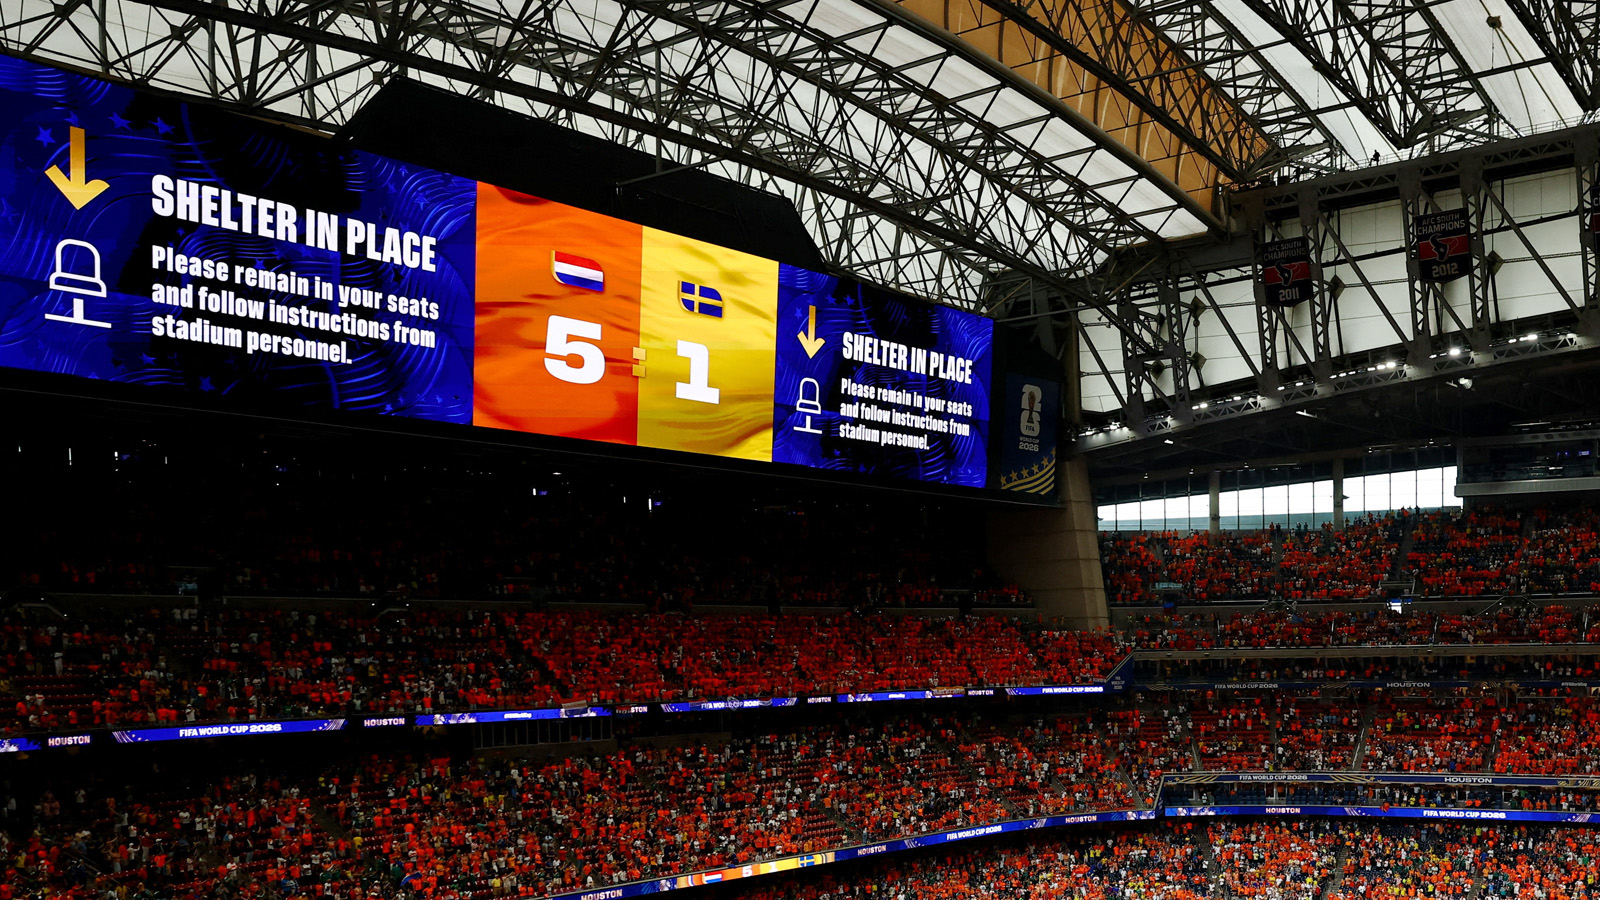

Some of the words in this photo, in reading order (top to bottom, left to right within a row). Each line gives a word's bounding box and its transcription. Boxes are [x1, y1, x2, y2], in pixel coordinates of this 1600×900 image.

[152, 174, 297, 243] SHELTER
[305, 208, 339, 252] IN
[346, 217, 437, 273] PLACE
[1422, 217, 1435, 226] AFC
[1436, 213, 1460, 223] SOUTH
[1417, 219, 1466, 236] CHAMPIONS
[1280, 240, 1302, 250] SOUTH
[1263, 247, 1306, 261] CHAMPIONS
[1431, 262, 1459, 278] 2012
[152, 244, 229, 282] Please
[235, 264, 309, 297] remain
[314, 275, 333, 301] in
[338, 284, 383, 311] your
[387, 294, 439, 320] seats
[1278, 287, 1300, 302] 2011
[152, 283, 194, 309] and
[197, 287, 265, 320] follow
[269, 298, 390, 341] instructions
[393, 320, 436, 349] from
[151, 314, 243, 348] stadium
[246, 330, 353, 365] personnel.
[544, 314, 606, 384] 5
[675, 339, 720, 405] 1
[842, 331, 908, 371] SHELTER
[910, 346, 927, 375] IN
[929, 351, 973, 385] PLACE
[840, 377, 876, 400] Please
[877, 387, 912, 406] remain
[913, 391, 923, 408] in
[924, 396, 946, 412] your
[947, 400, 973, 417] seats
[839, 401, 860, 419] and
[860, 403, 891, 424] follow
[891, 408, 949, 433] instructions
[949, 418, 970, 437] from
[838, 422, 880, 443] stadium
[880, 430, 931, 450] personnel.
[1018, 441, 1040, 453] 2026
[364, 718, 406, 726] HOUSTON
[180, 728, 198, 737] FIFA
[199, 726, 229, 736] WORLD
[230, 725, 248, 734] CUP
[249, 724, 282, 732] 2026
[48, 735, 90, 746] HOUSTON
[1066, 815, 1097, 824] HOUSTON
[958, 830, 976, 838] WORLD
[858, 844, 886, 856] HOUSTON
[742, 865, 752, 878] 5
[769, 862, 778, 872] 1
[581, 888, 622, 900] HOUSTON
